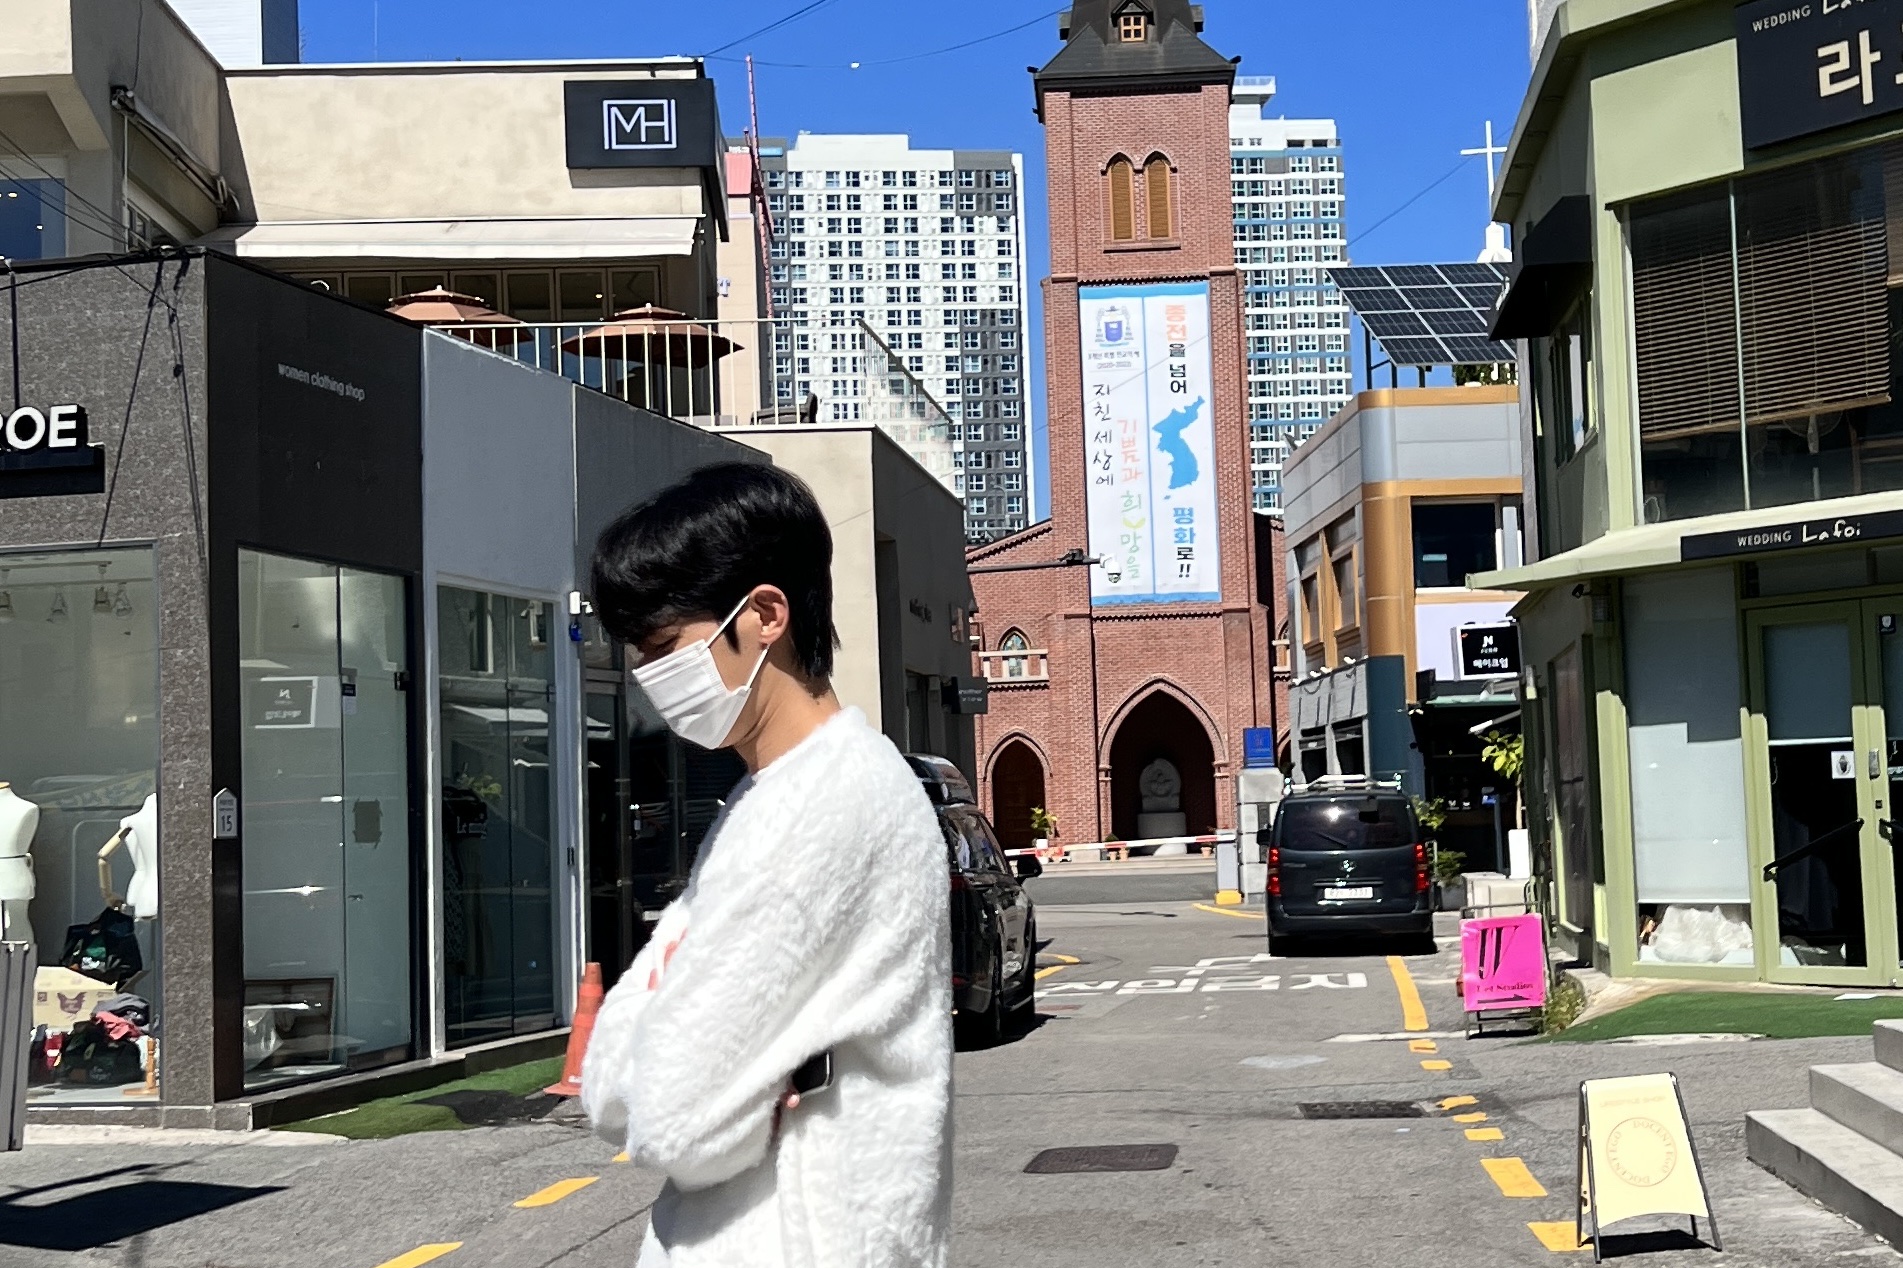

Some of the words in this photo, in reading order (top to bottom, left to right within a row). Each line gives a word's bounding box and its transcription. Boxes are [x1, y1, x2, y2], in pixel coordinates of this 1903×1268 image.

[1752, 5, 1811, 32] WEDDING
[1817, 29, 1903, 105] 라
[278, 363, 310, 384] women
[311, 371, 345, 396] clothing
[345, 382, 366, 402] shop
[1169, 363, 1188, 394] 넘어
[1093, 384, 1112, 421] 지친
[0, 405, 78, 450] OE
[1093, 431, 1114, 486] 세상에
[1117, 419, 1142, 483] 기쁨과
[1120, 490, 1143, 579] 희망을
[1172, 507, 1196, 578] 평화로!!
[1737, 531, 1792, 547] WEDDING
[1802, 519, 1861, 543] Lafoi
[221, 815, 233, 832] 15
[1034, 971, 1368, 998] 진입금지
